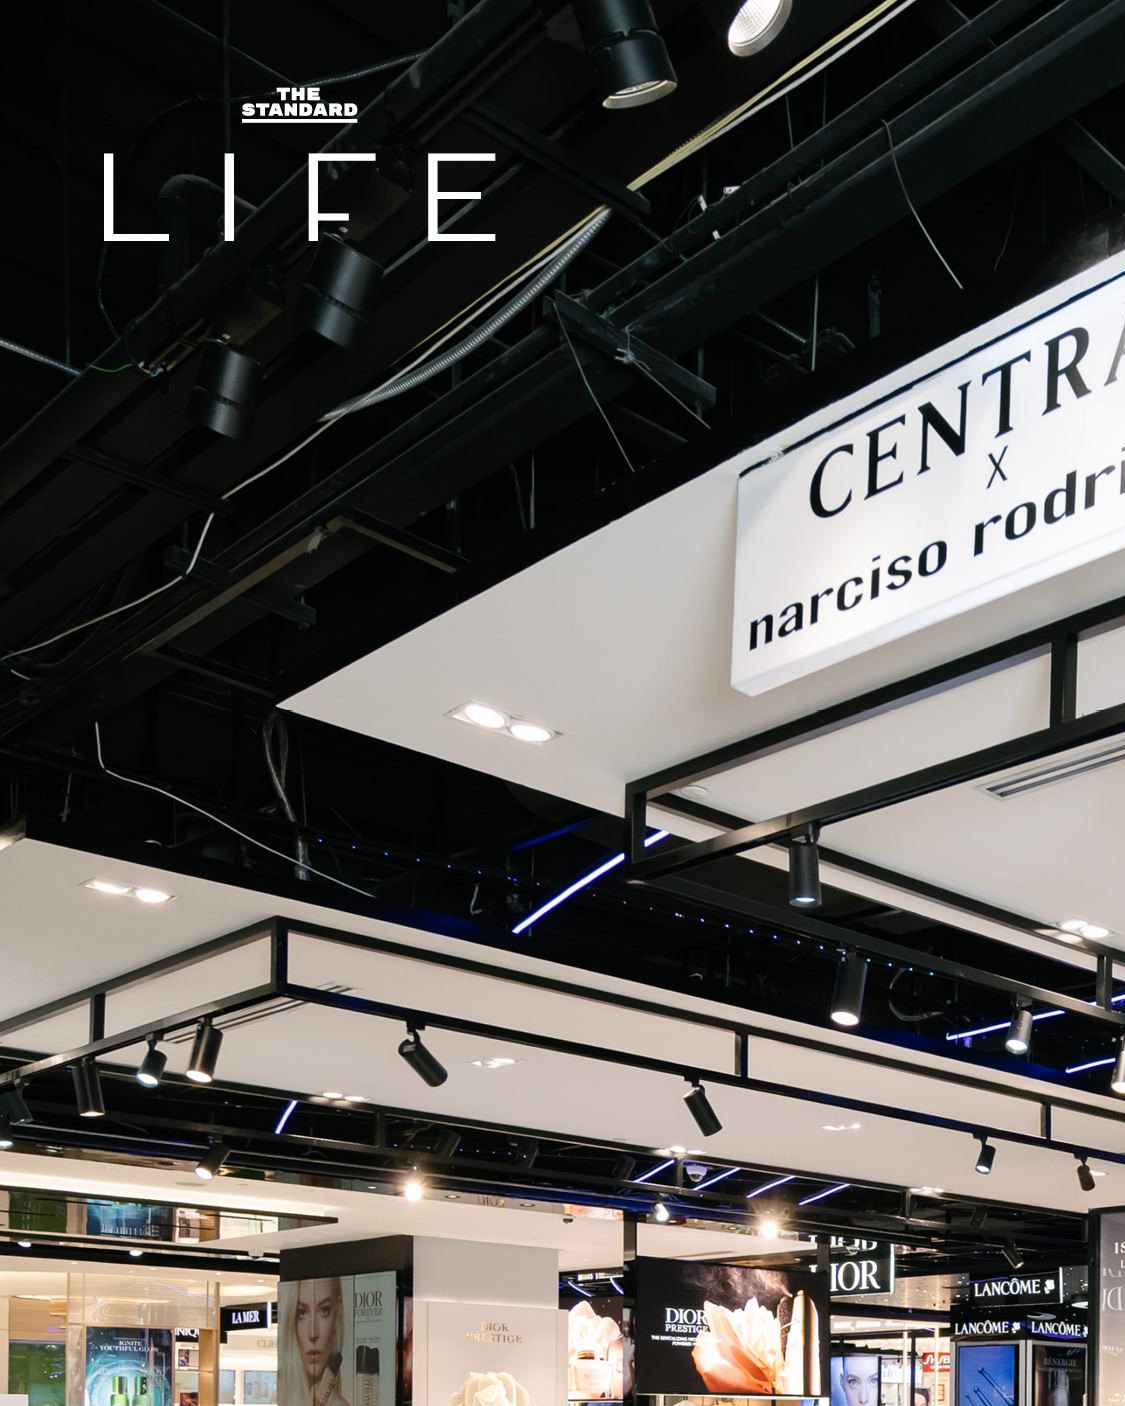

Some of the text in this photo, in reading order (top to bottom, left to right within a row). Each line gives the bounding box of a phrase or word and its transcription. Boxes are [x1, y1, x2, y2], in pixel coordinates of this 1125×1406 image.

[748, 539, 948, 651] narciso
[974, 1277, 1041, 1297] LANCÔME
[355, 1291, 383, 1308] DIOR
[232, 1310, 260, 1324] LA MER
[665, 1308, 708, 1325] DIOR
[480, 1322, 509, 1332] DIOR
[665, 1324, 709, 1333] PRESTIGE
[955, 1320, 1009, 1335] LANCÔME
[1031, 1321, 1081, 1336] LANCÔME
[466, 1333, 523, 1344] PRESTIGE
